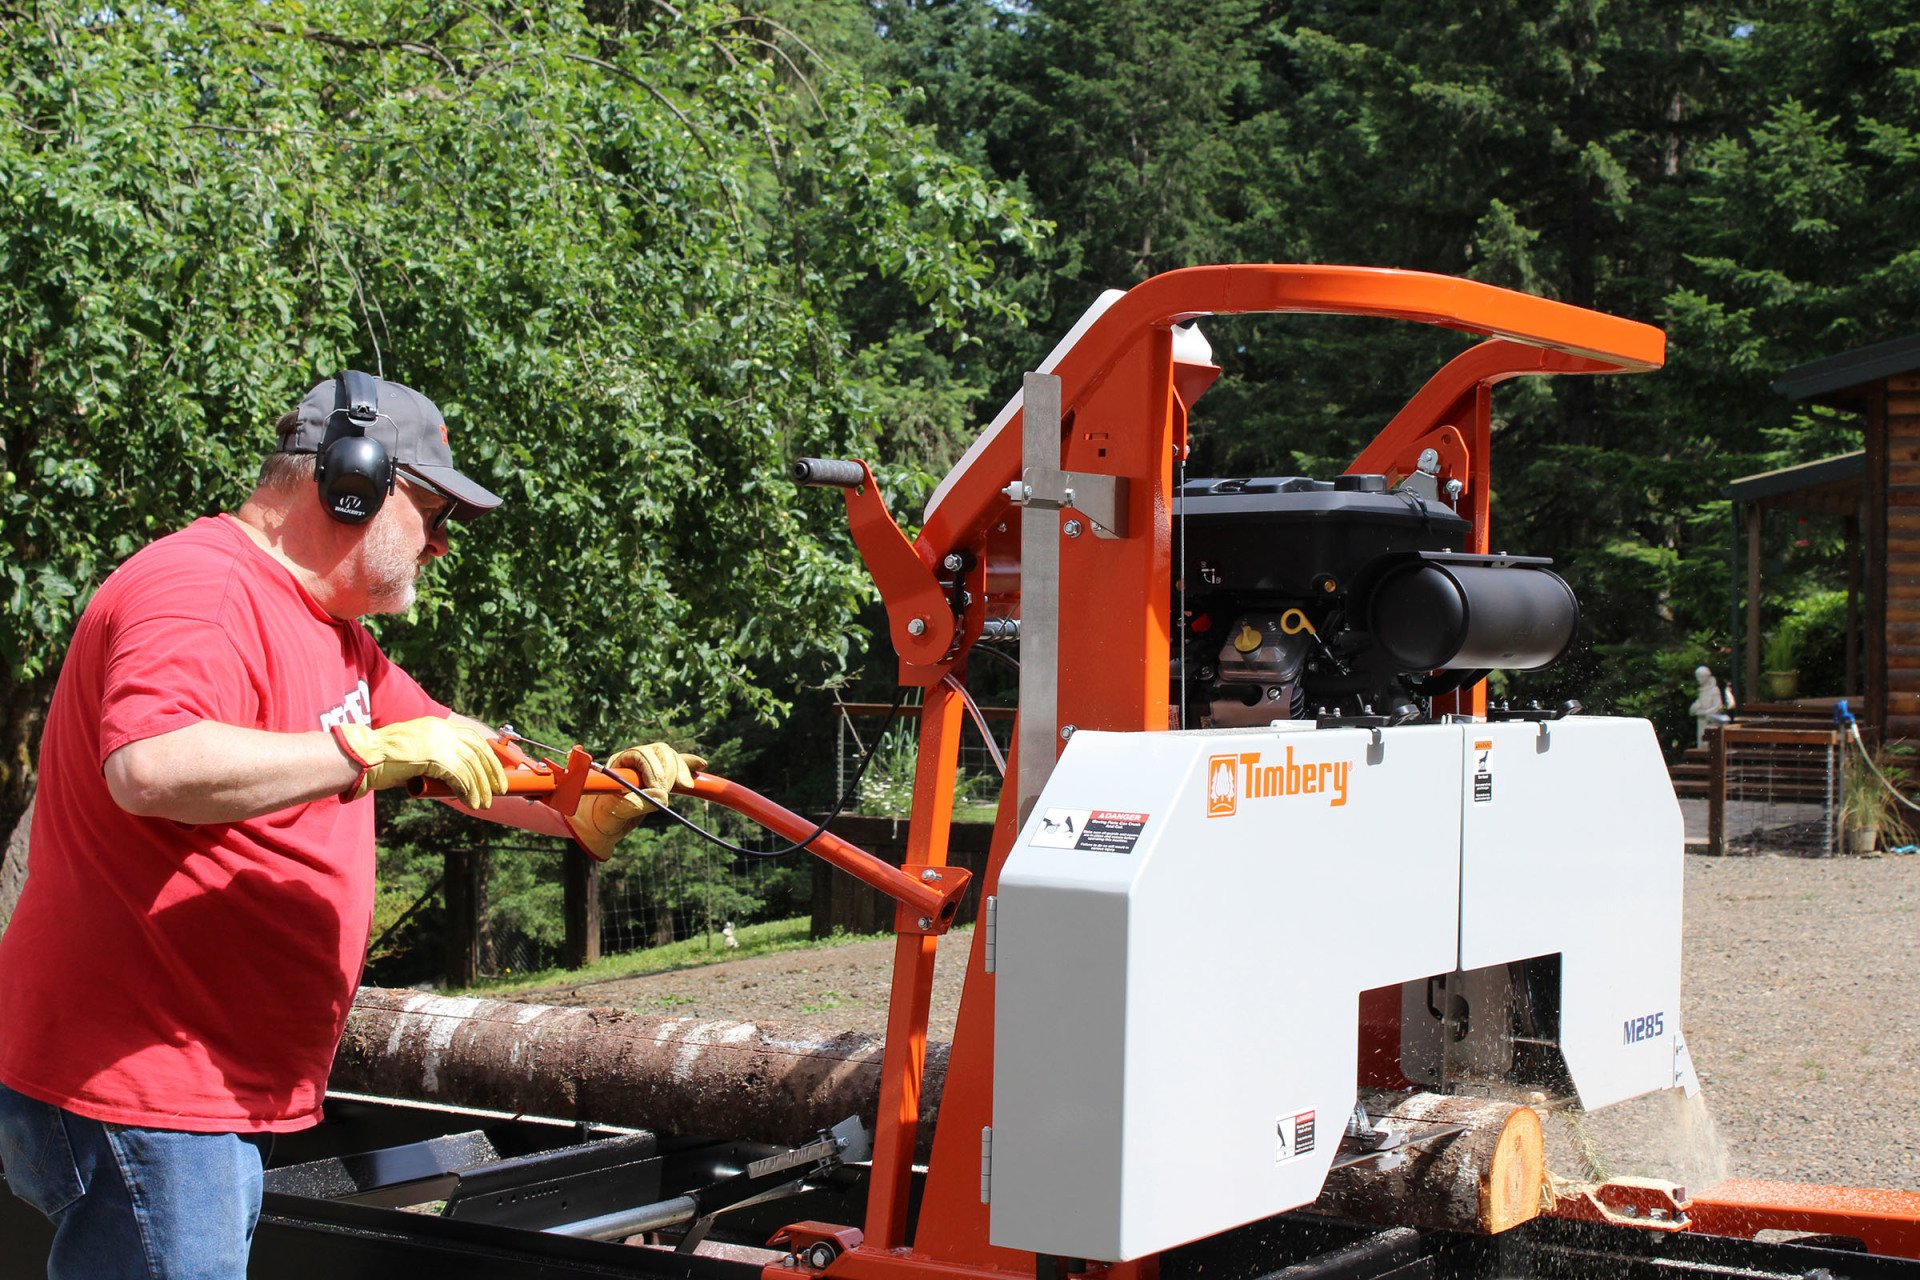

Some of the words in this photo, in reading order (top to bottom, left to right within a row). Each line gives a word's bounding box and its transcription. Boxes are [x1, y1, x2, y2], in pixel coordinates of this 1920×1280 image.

[1240, 746, 1348, 807] Timbery
[1105, 813, 1141, 821] DANGER
[1623, 1012, 1664, 1045] M285
